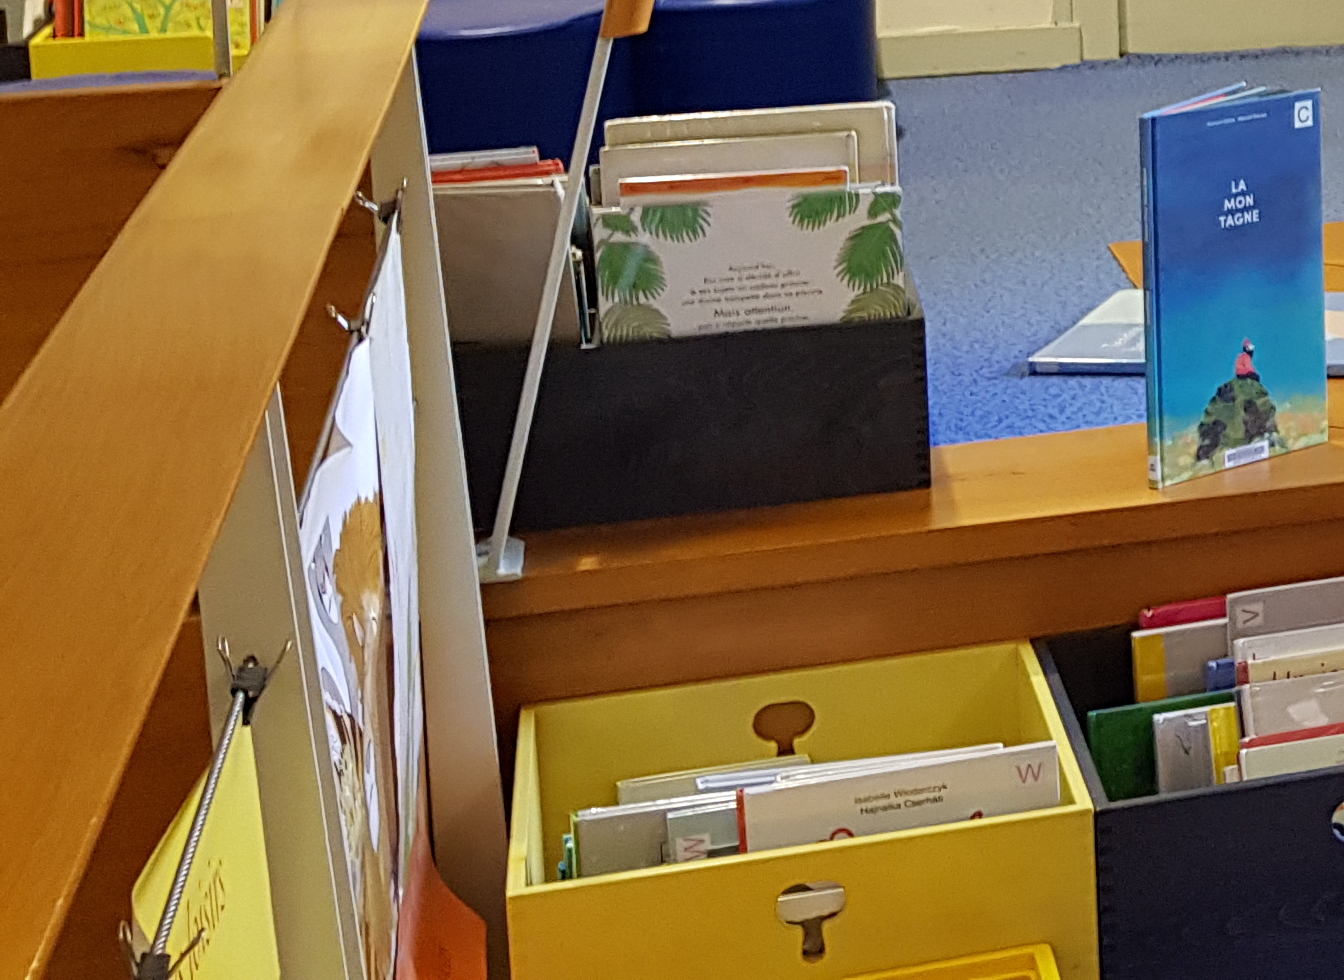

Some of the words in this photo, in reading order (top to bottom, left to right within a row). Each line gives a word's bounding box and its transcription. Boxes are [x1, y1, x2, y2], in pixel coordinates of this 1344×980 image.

[1297, 106, 1310, 124] C
[1231, 179, 1247, 194] LA
[1224, 194, 1254, 212] MON
[1219, 209, 1260, 229] TAGNE
[1015, 762, 1043, 785] W
